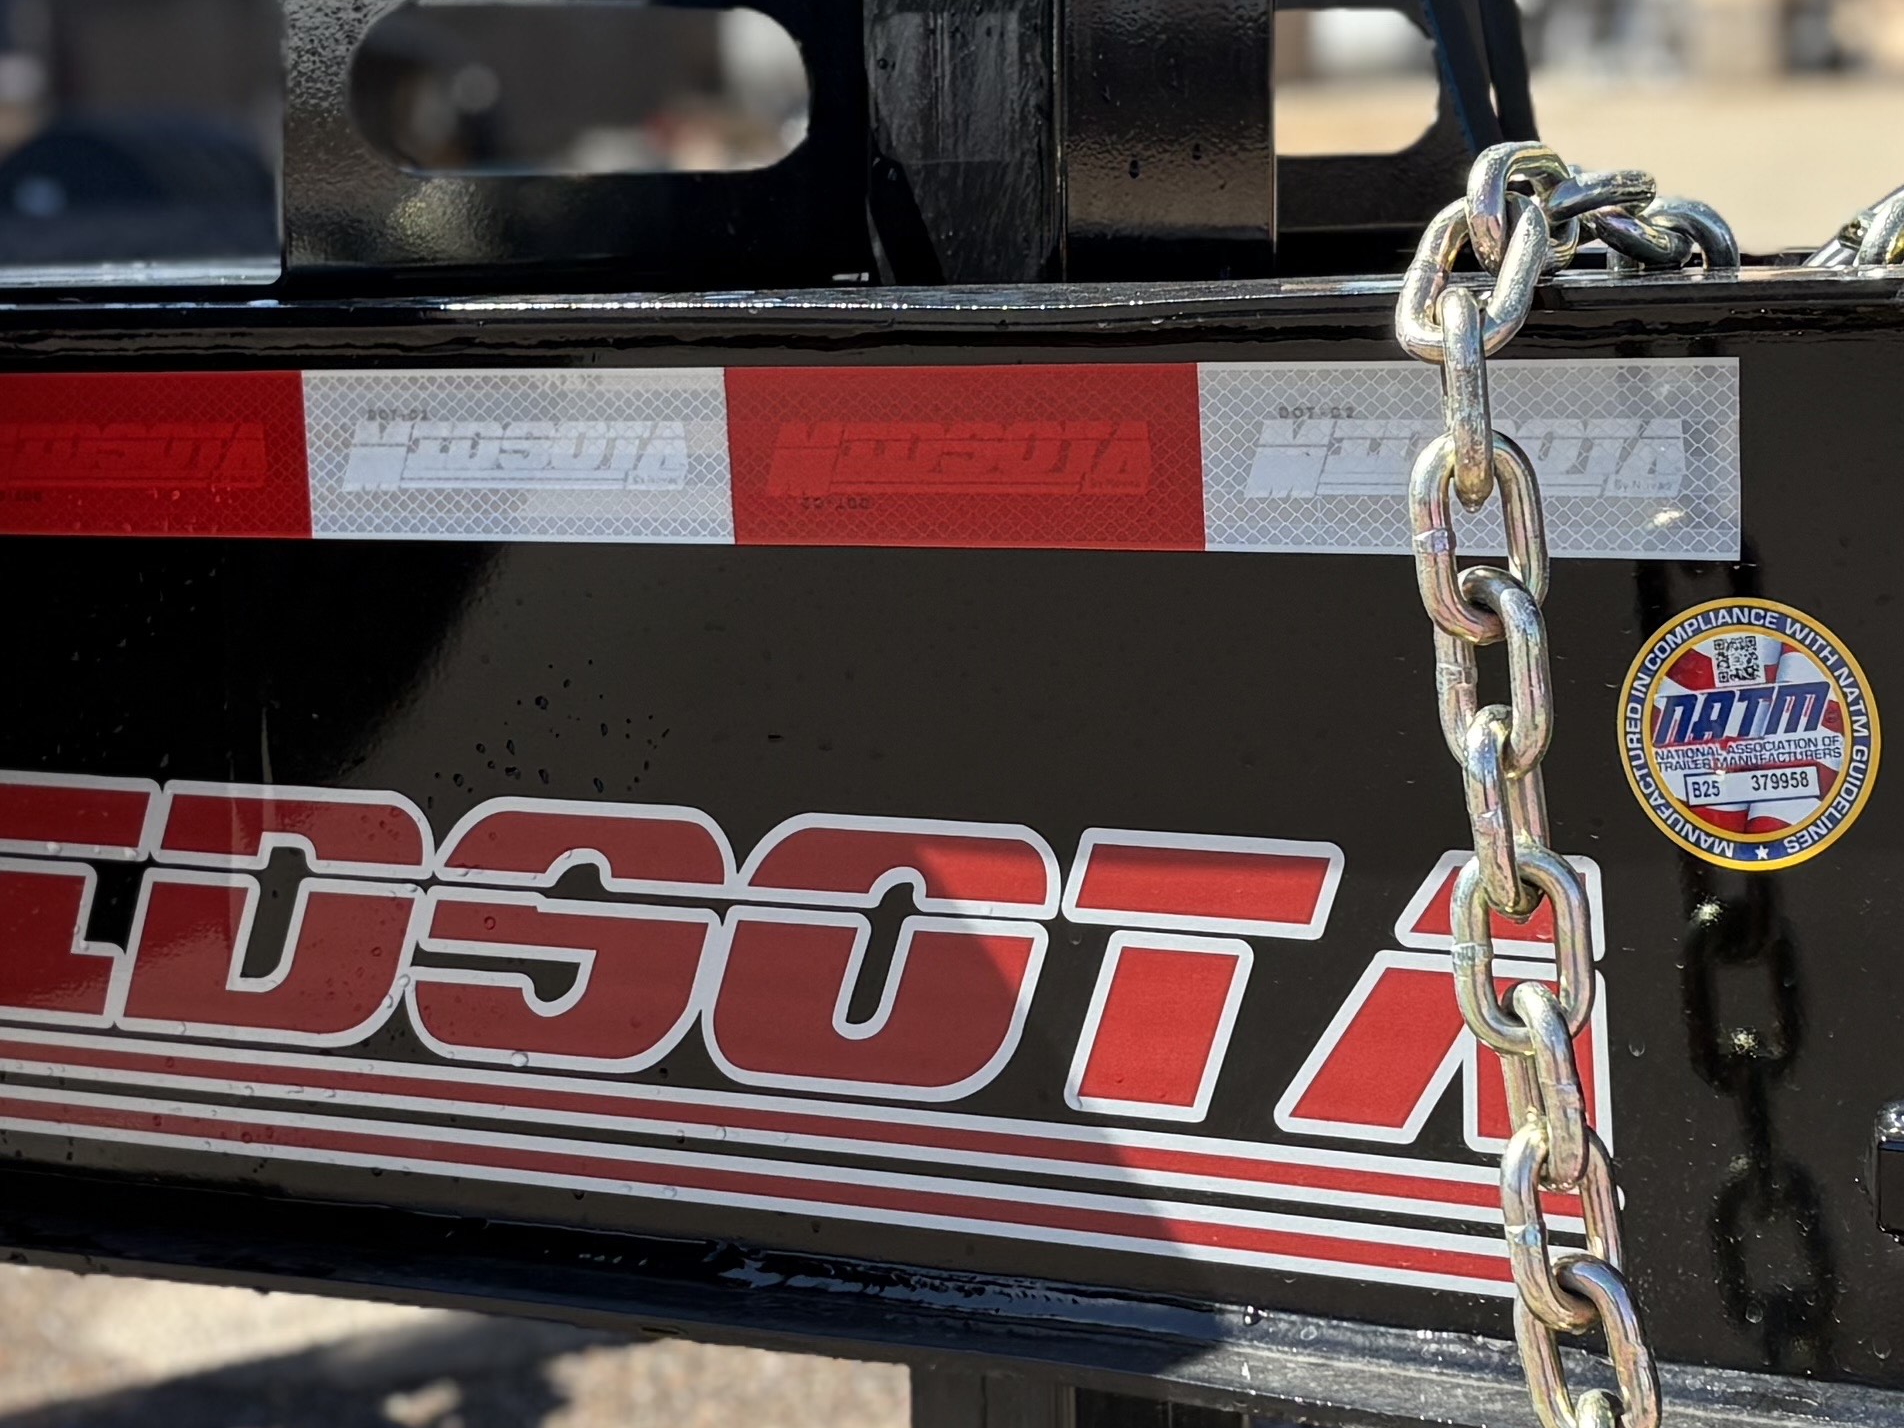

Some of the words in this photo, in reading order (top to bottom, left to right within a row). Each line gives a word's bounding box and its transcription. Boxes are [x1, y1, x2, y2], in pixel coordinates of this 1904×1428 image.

[1646, 606, 1778, 672] COMPLIANCE
[1784, 617, 1839, 667] WITH
[1630, 671, 1651, 700] IN
[1835, 666, 1870, 738] NATM
[1654, 746, 1723, 763] NATIONAL
[1726, 738, 1819, 756] ASSOCIATION
[1821, 735, 1841, 748] OF
[1656, 758, 1712, 773] TRAILER
[1715, 746, 1843, 769] MANUFACTURERS
[1625, 706, 1735, 859] MANUFACTURED
[1691, 779, 1722, 799] B25
[1750, 771, 1811, 793] 379958
[1782, 744, 1869, 854] GUIDELINES
